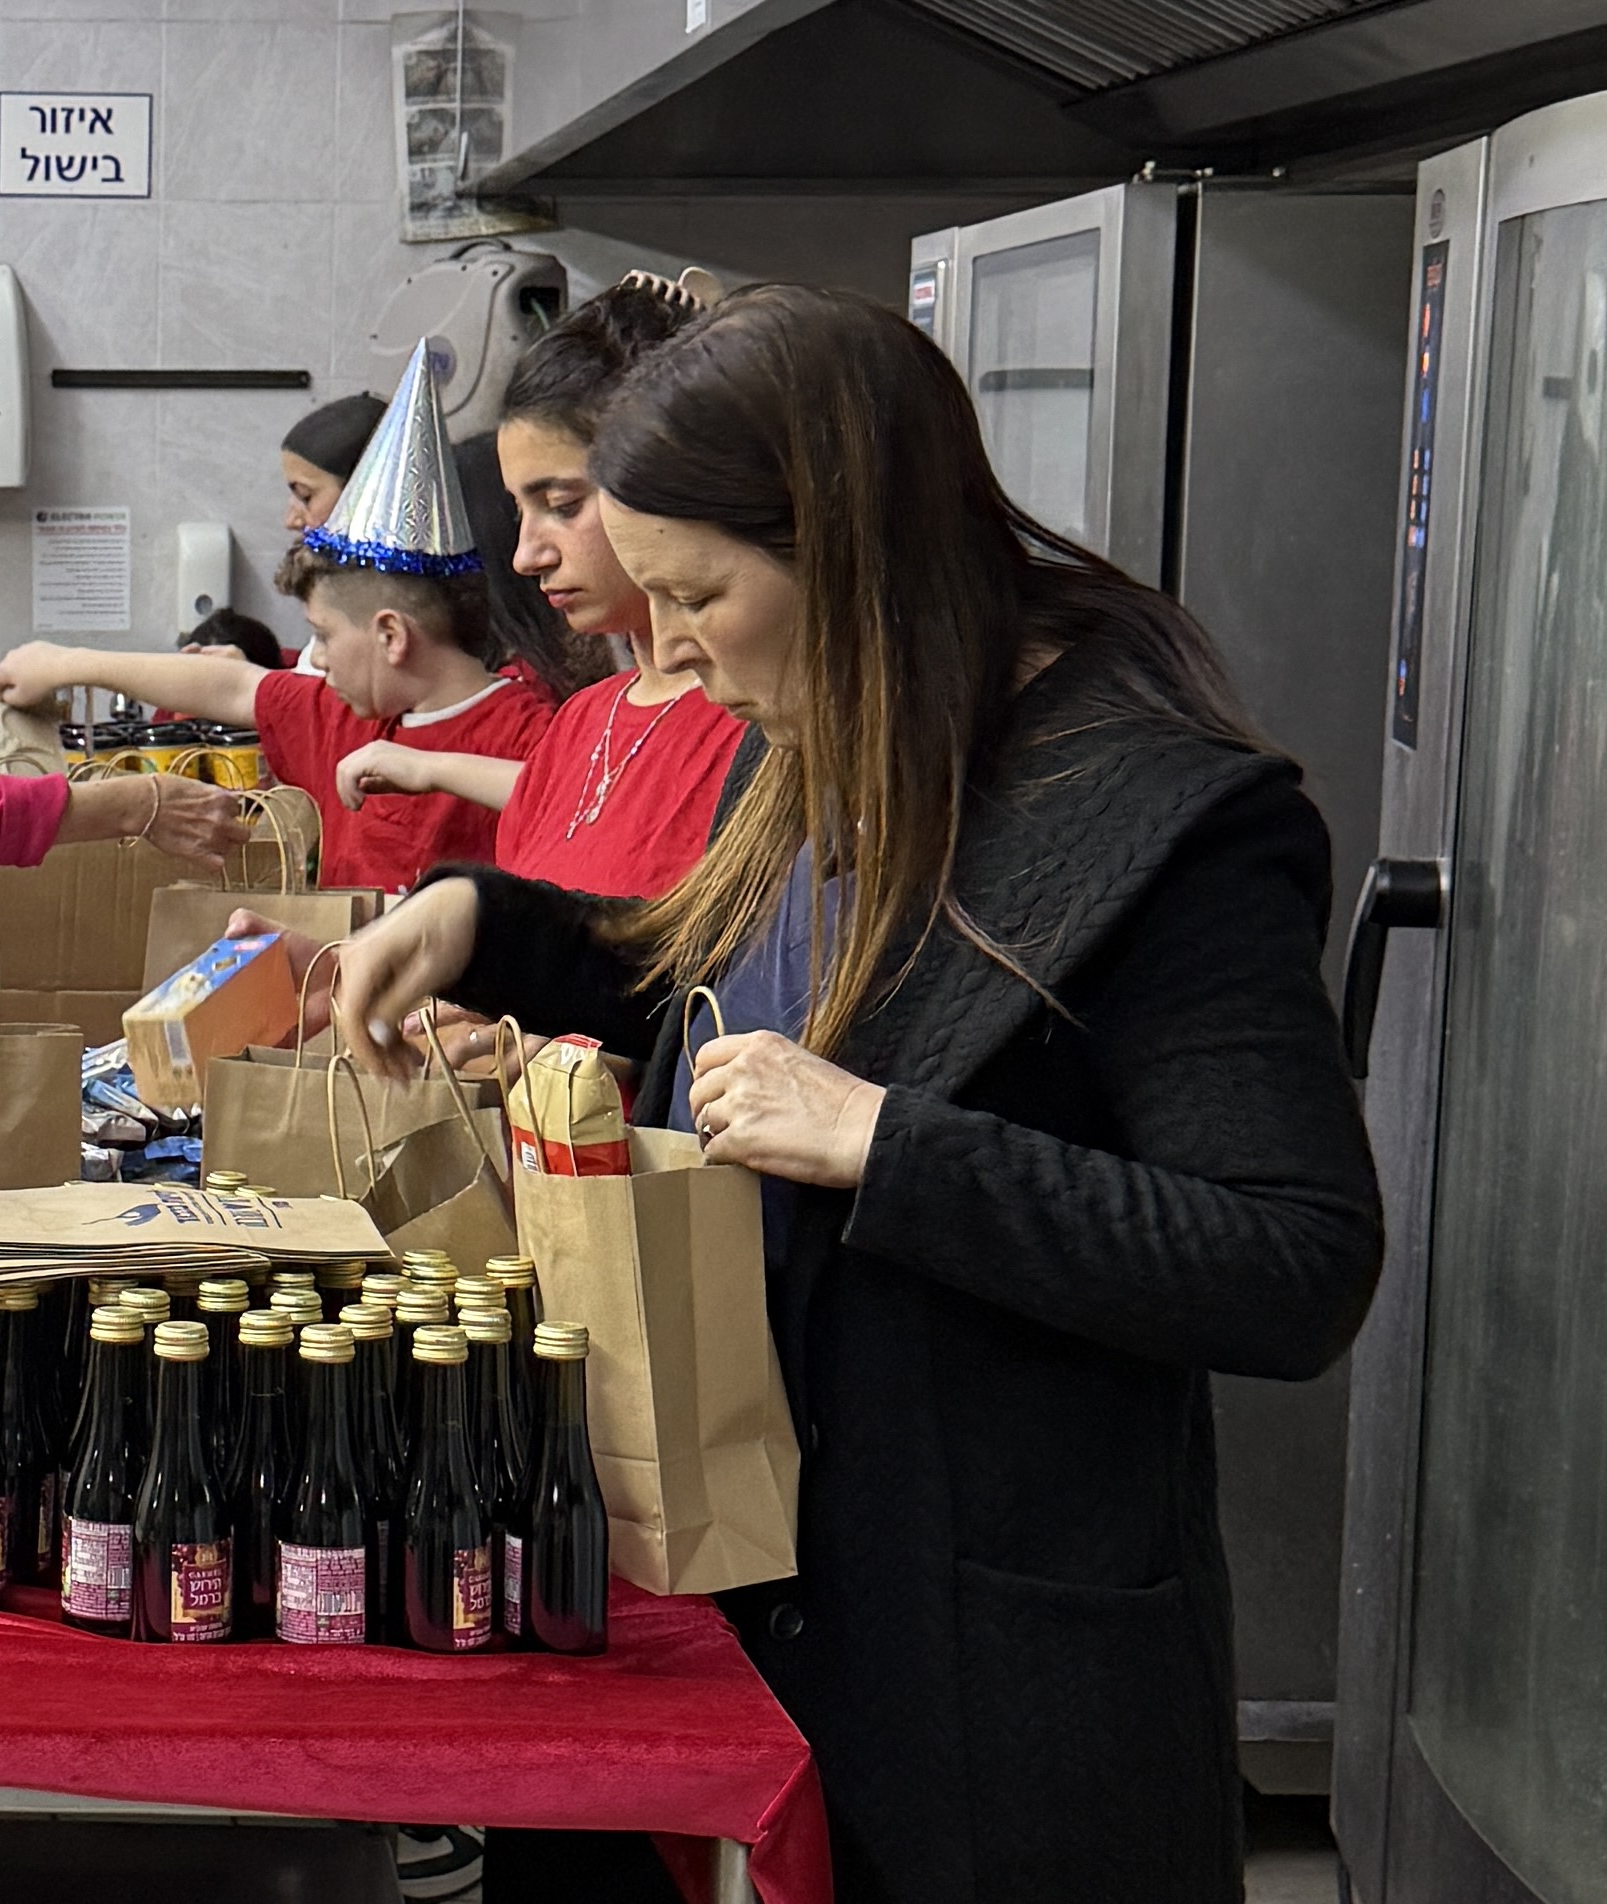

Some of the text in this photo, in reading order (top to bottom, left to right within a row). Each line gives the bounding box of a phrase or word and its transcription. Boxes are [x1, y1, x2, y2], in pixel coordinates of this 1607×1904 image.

[28, 106, 114, 135] איזור
[21, 147, 125, 182] בישול
[190, 1592, 221, 1607] כרמל
